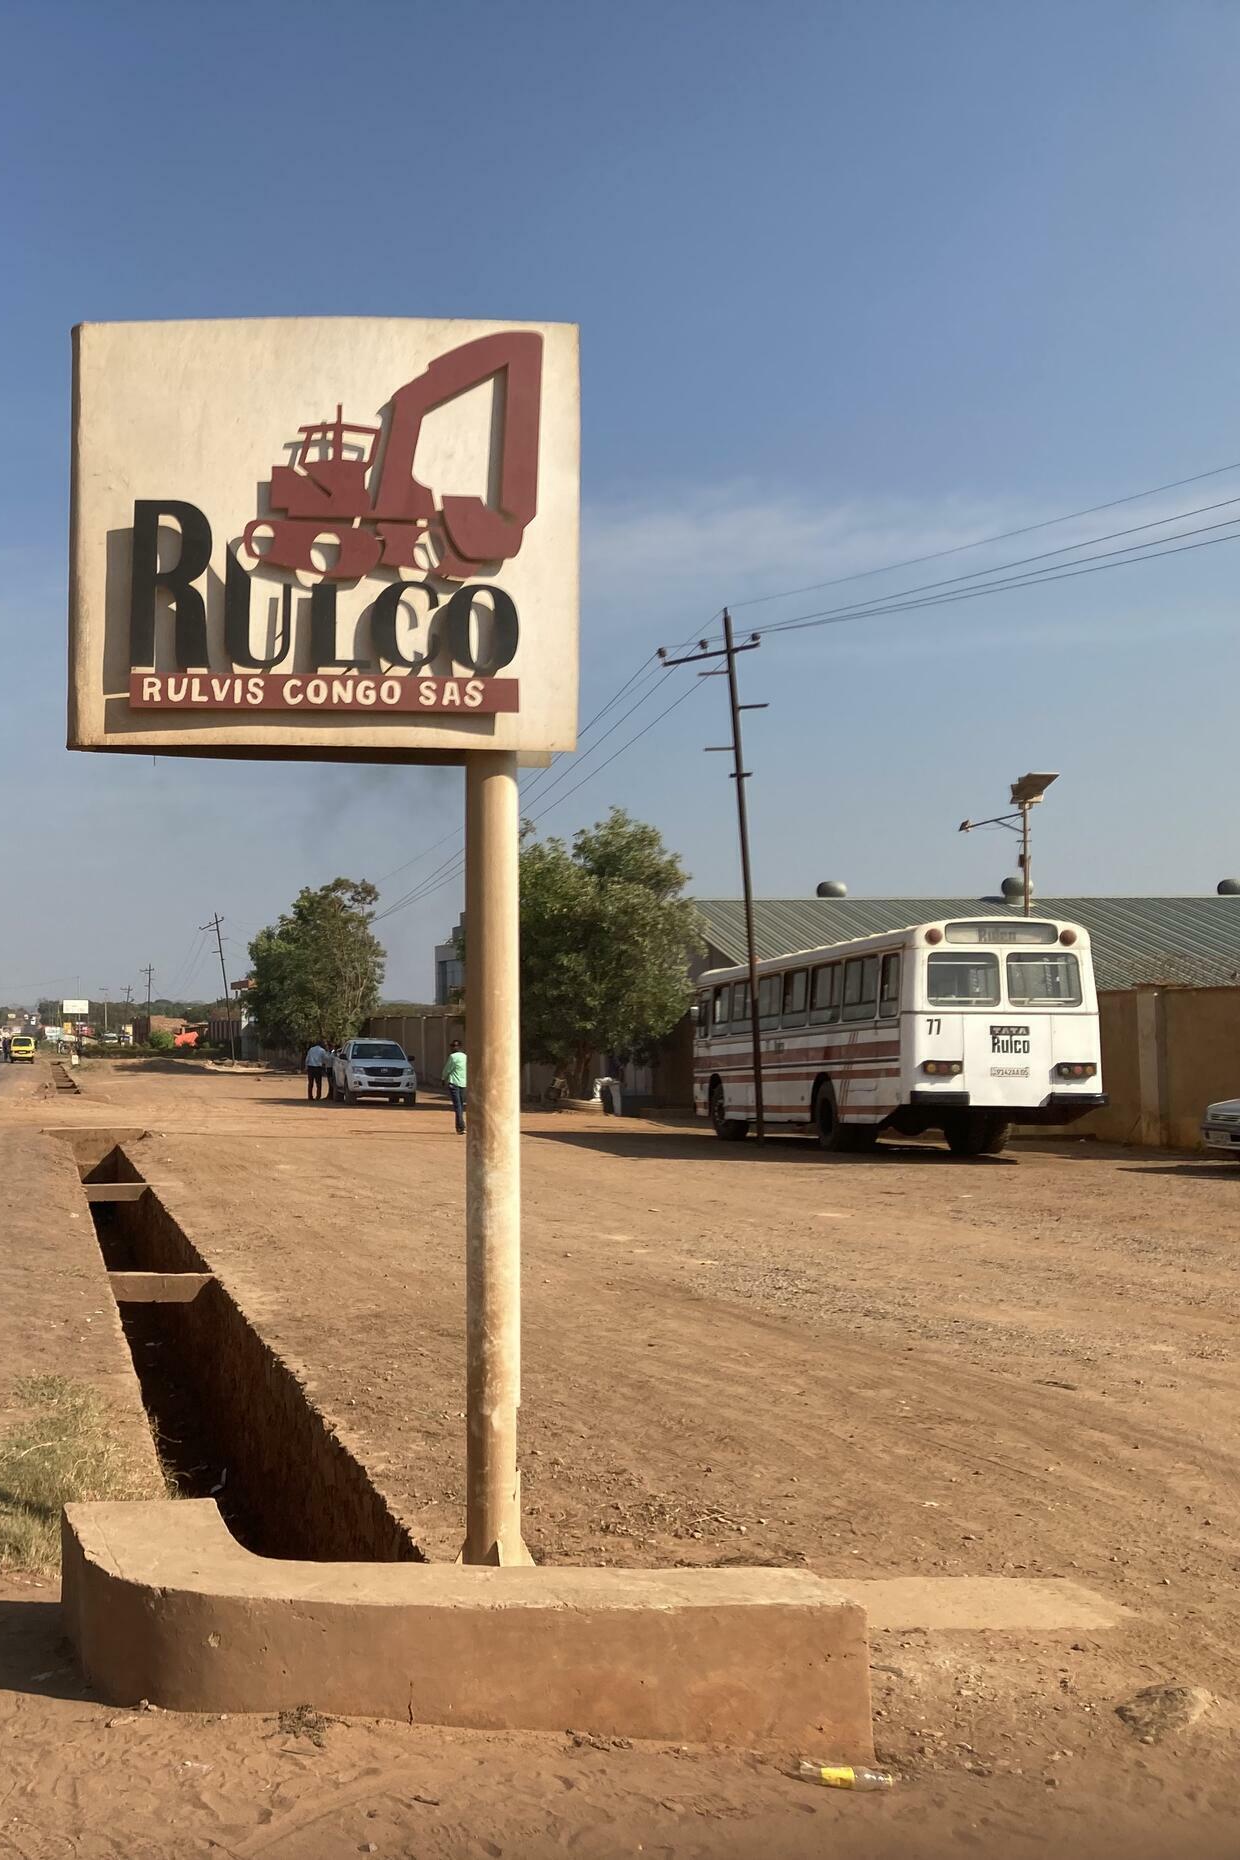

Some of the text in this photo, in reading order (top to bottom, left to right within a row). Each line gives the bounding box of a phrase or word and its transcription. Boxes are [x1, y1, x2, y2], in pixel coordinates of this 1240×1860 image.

[142, 677, 486, 708] RULVIS CONGO SAS
[926, 1018, 942, 1036] 77
[991, 1027, 1028, 1035] TATA
